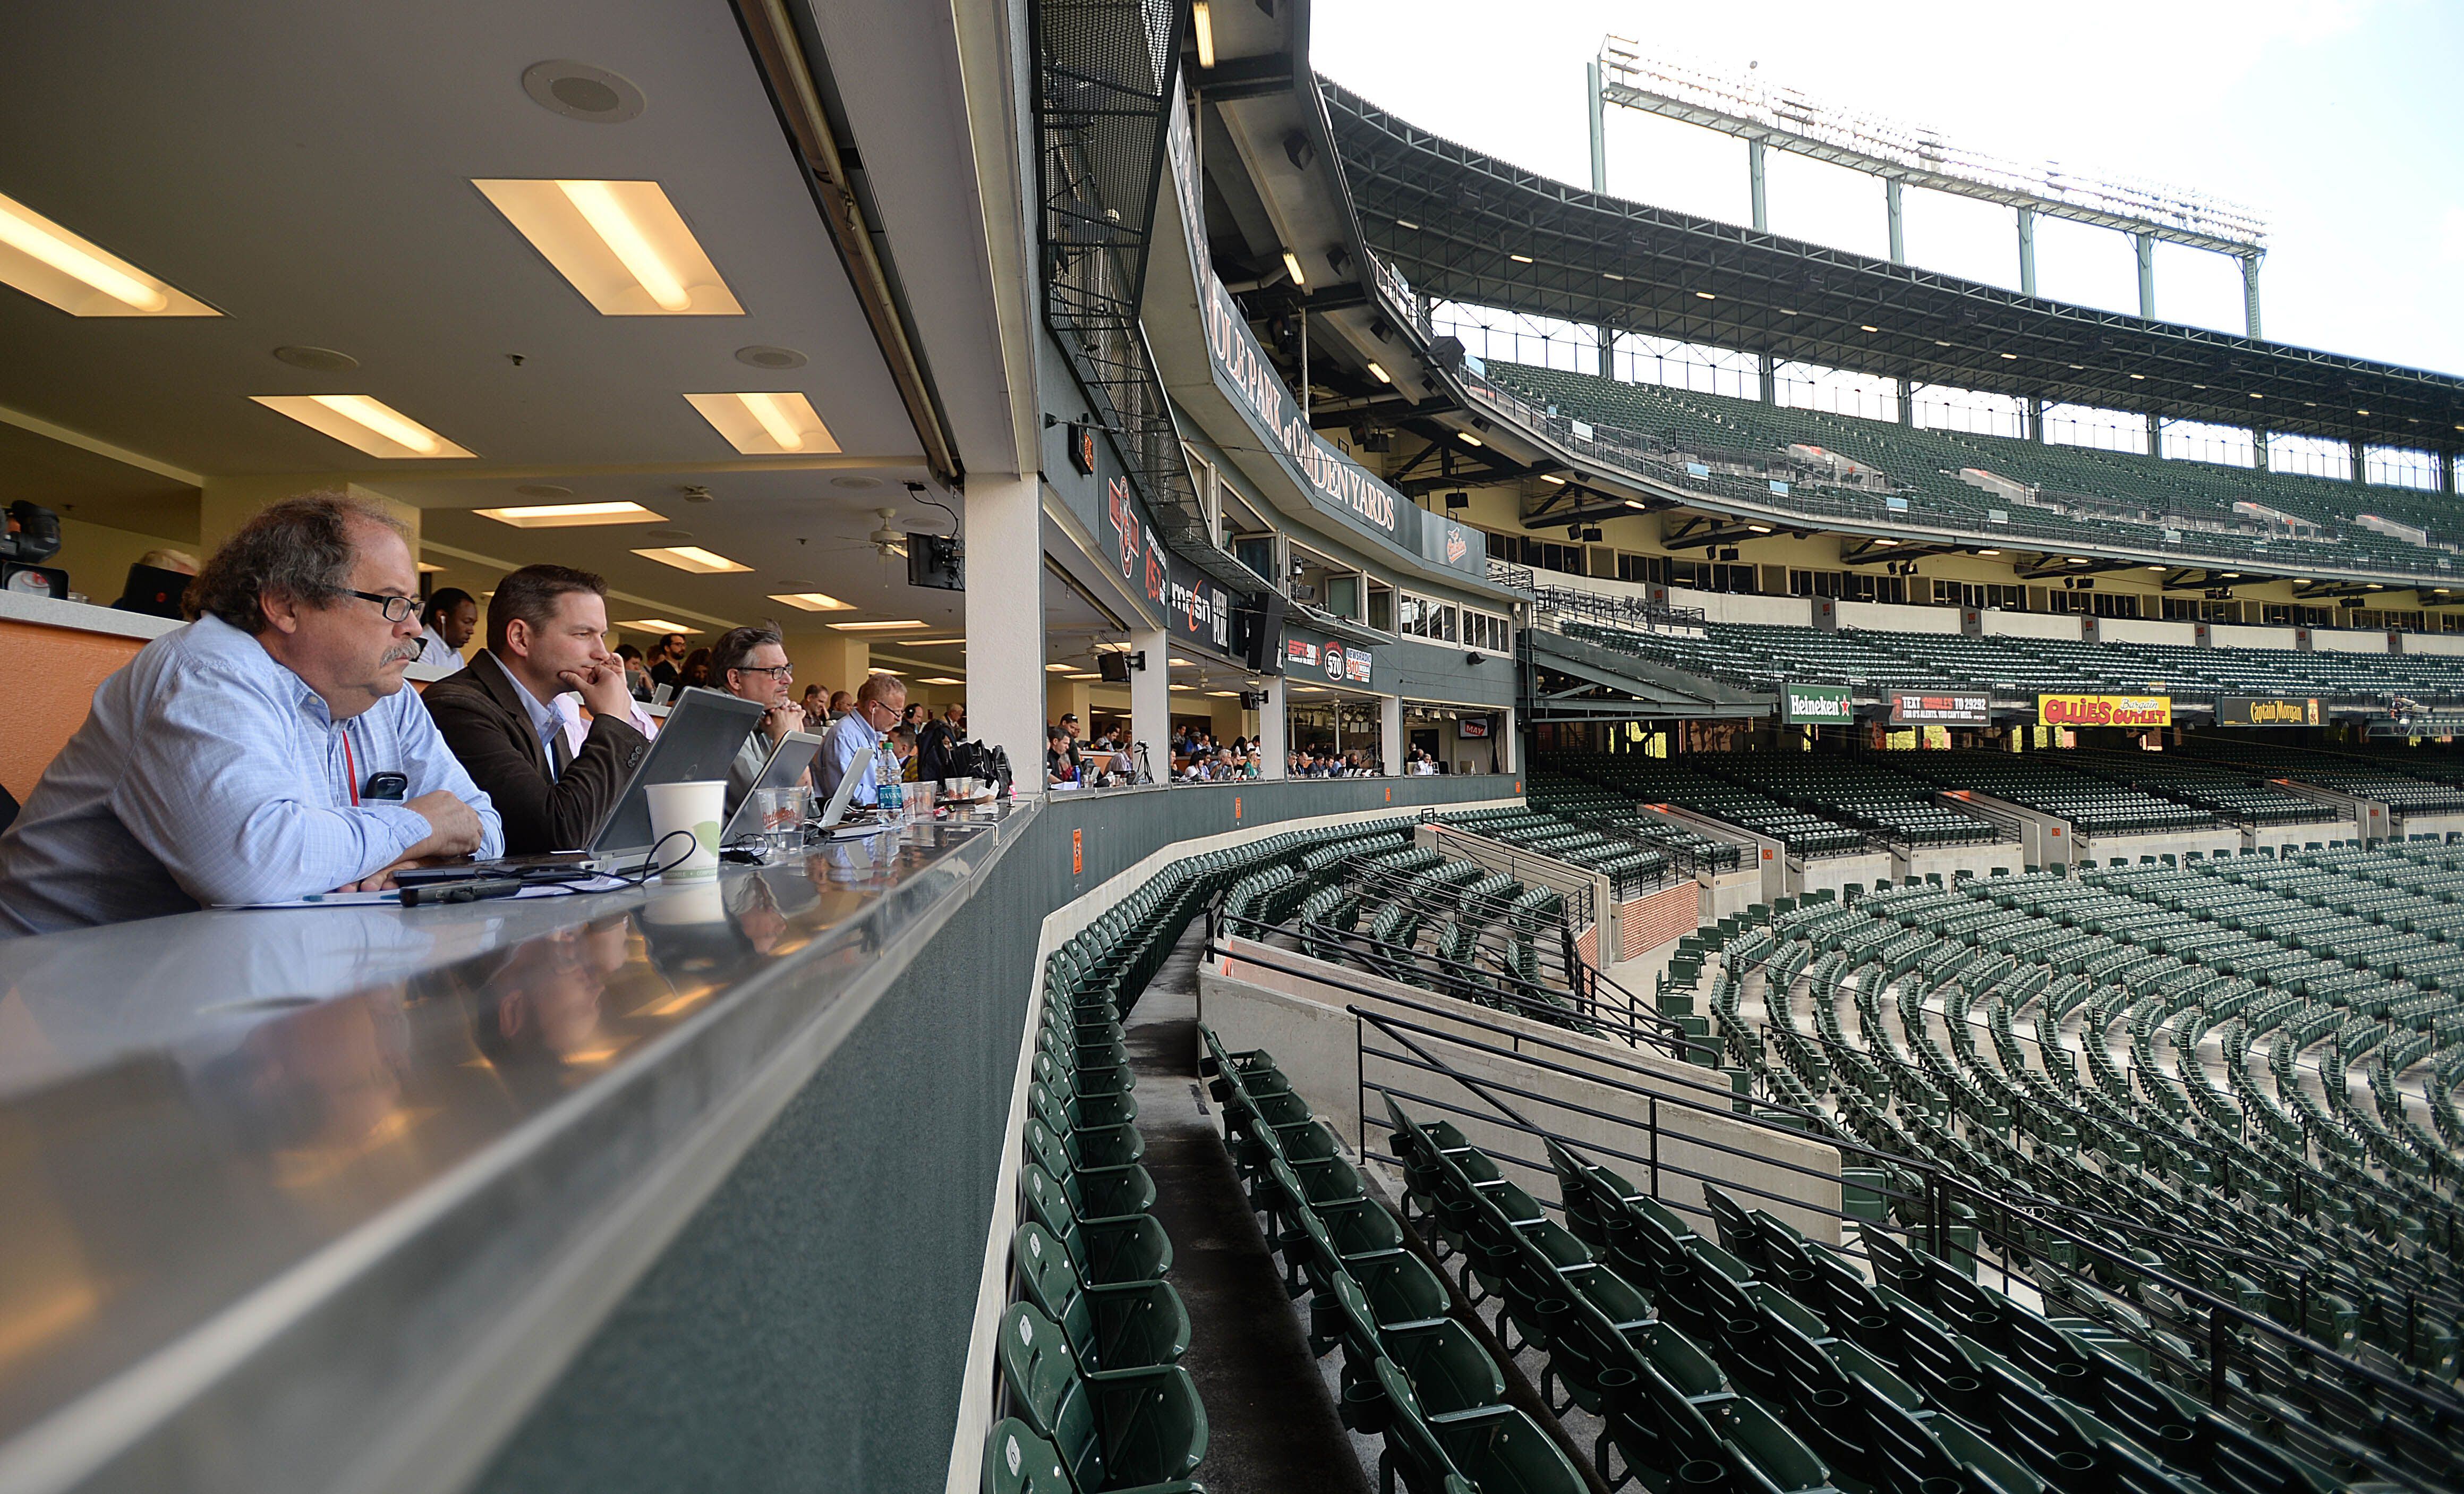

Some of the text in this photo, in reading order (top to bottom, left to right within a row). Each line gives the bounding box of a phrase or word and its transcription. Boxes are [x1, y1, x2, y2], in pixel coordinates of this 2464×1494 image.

[1246, 345, 1283, 443] PARK
[1292, 416, 1349, 505] CAMDEN
[1347, 468, 1395, 532] YARDS
[1172, 582, 1211, 624] masn
[1212, 587, 1228, 618] EVERY
[1327, 655, 1342, 675] 570
[1346, 659, 1359, 675] 910
[1790, 694, 1839, 716] Heineken
[1902, 697, 1921, 709] TEXT
[1954, 698, 1964, 710] TO
[1964, 698, 1986, 711] 29292
[2120, 698, 2159, 712] Bargain
[2250, 700, 2303, 724] Captain Morgan
[1903, 710, 1912, 718] FOR
[1938, 710, 1948, 719] YOU
[2112, 708, 2166, 725] OUTLET
[1466, 725, 1484, 736] MAY
